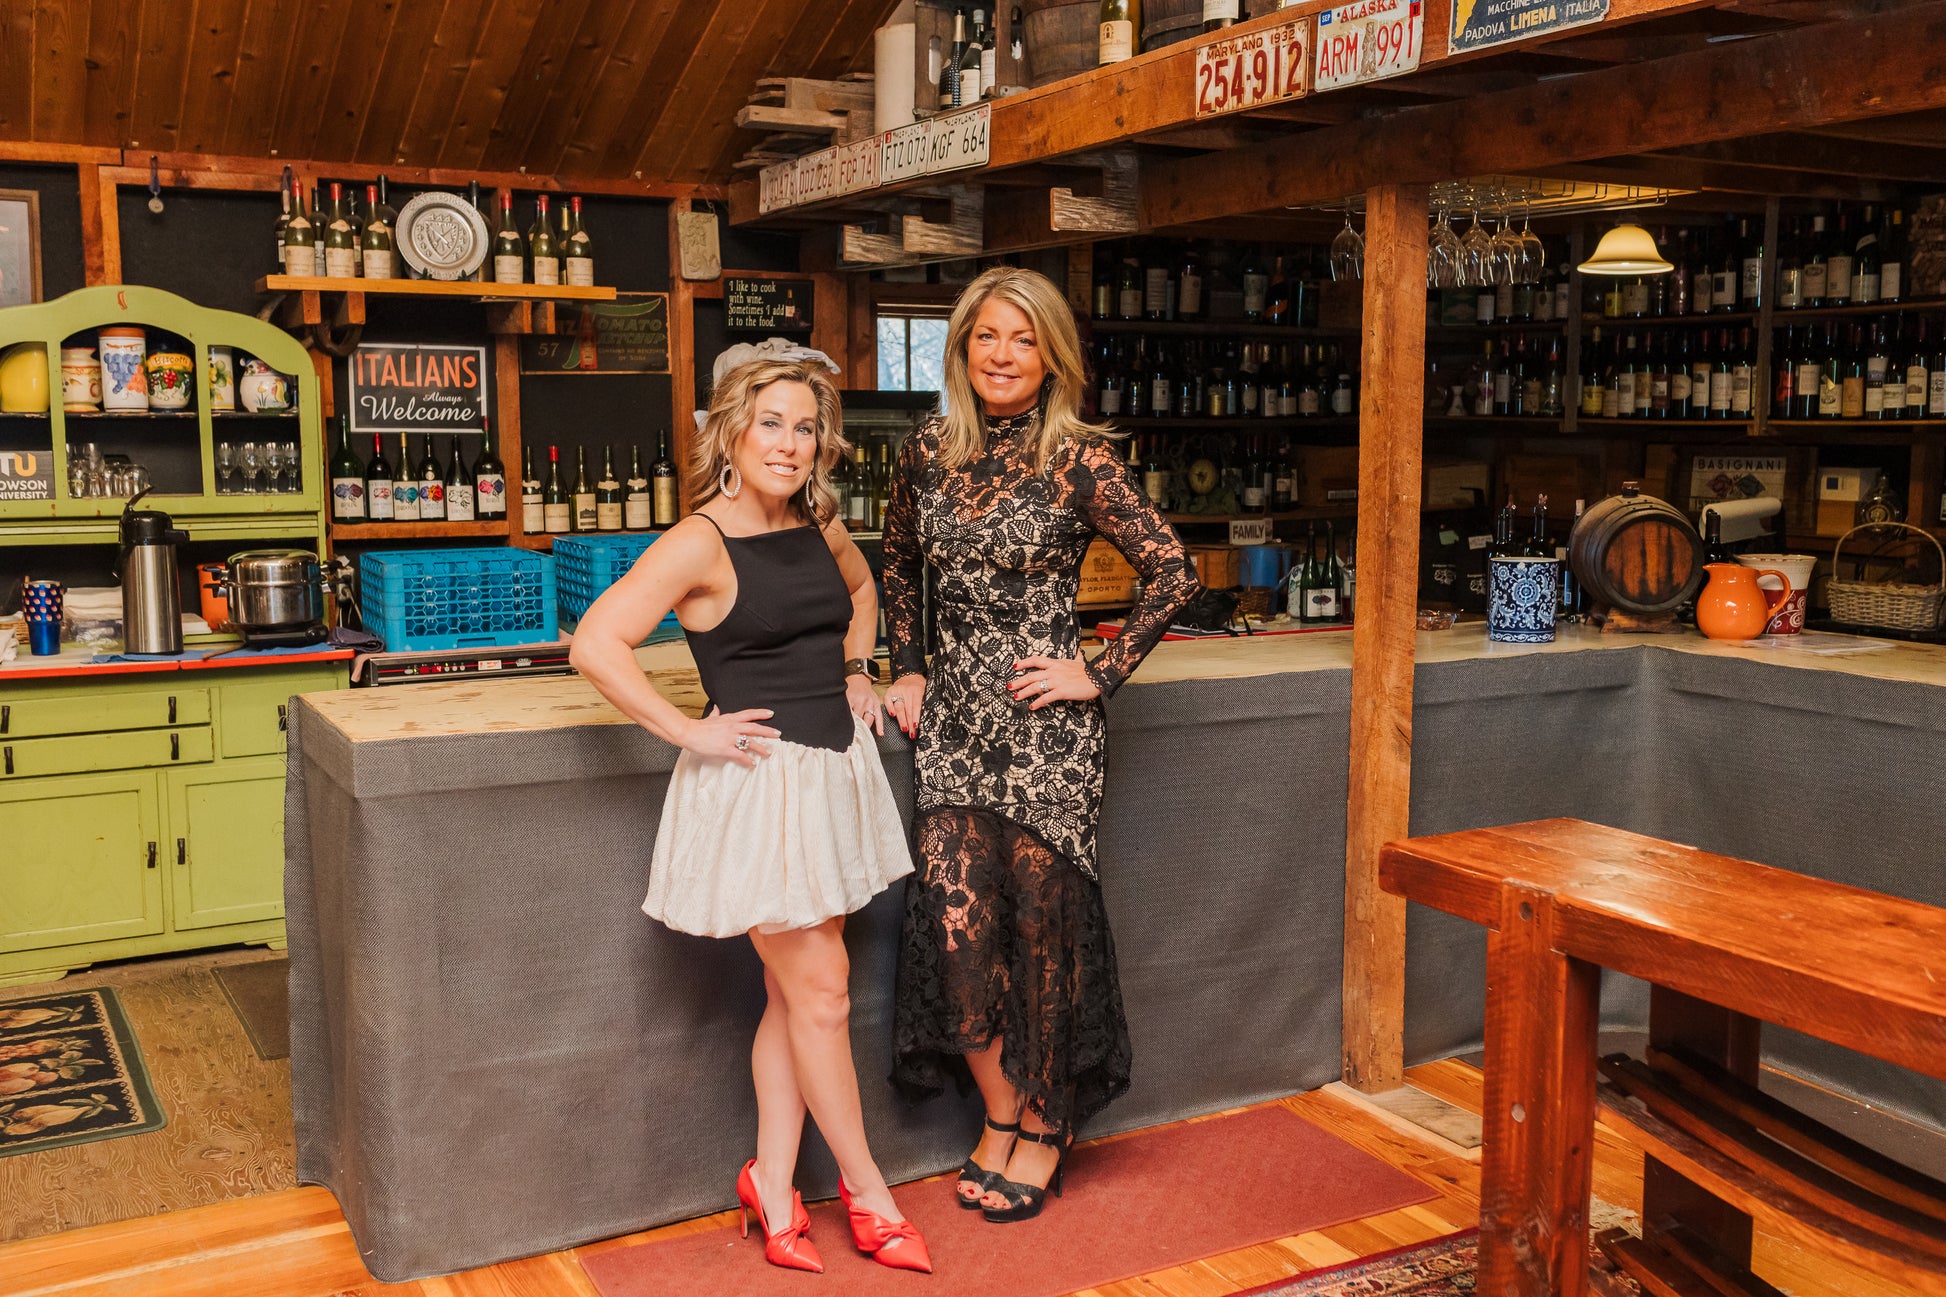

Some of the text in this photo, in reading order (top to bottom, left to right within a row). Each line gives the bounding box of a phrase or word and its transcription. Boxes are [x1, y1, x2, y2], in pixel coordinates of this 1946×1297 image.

[1340, 0, 1398, 23] ALASKA
[1487, 0, 1534, 16] MACCHINE
[1321, 14, 1331, 23] SEP
[1465, 0, 1600, 42] PADOVA LIMENA ITALIA
[1206, 29, 1295, 61] MARYLAND 1932
[1319, 17, 1414, 79] ARM 991
[930, 121, 986, 163] KGF 664
[885, 135, 927, 172] FTZ 073
[817, 163, 834, 190] 282
[839, 151, 878, 186] FCP 741
[736, 280, 749, 292] like
[751, 282, 758, 292] to
[760, 281, 777, 293] cook
[728, 292, 764, 304] with wine.
[728, 303, 764, 315] Sometimes
[772, 304, 785, 316] add
[728, 315, 776, 327] it to the food.
[537, 342, 560, 358] 57
[356, 353, 478, 389] ITALIANS
[422, 391, 463, 406] Always
[360, 395, 476, 421] Welcome
[1698, 458, 1782, 471] BASIGNANI
[0, 479, 47, 491] OWSON
[1232, 524, 1265, 540] FAMILY
[1087, 585, 1121, 593] OPORTO
